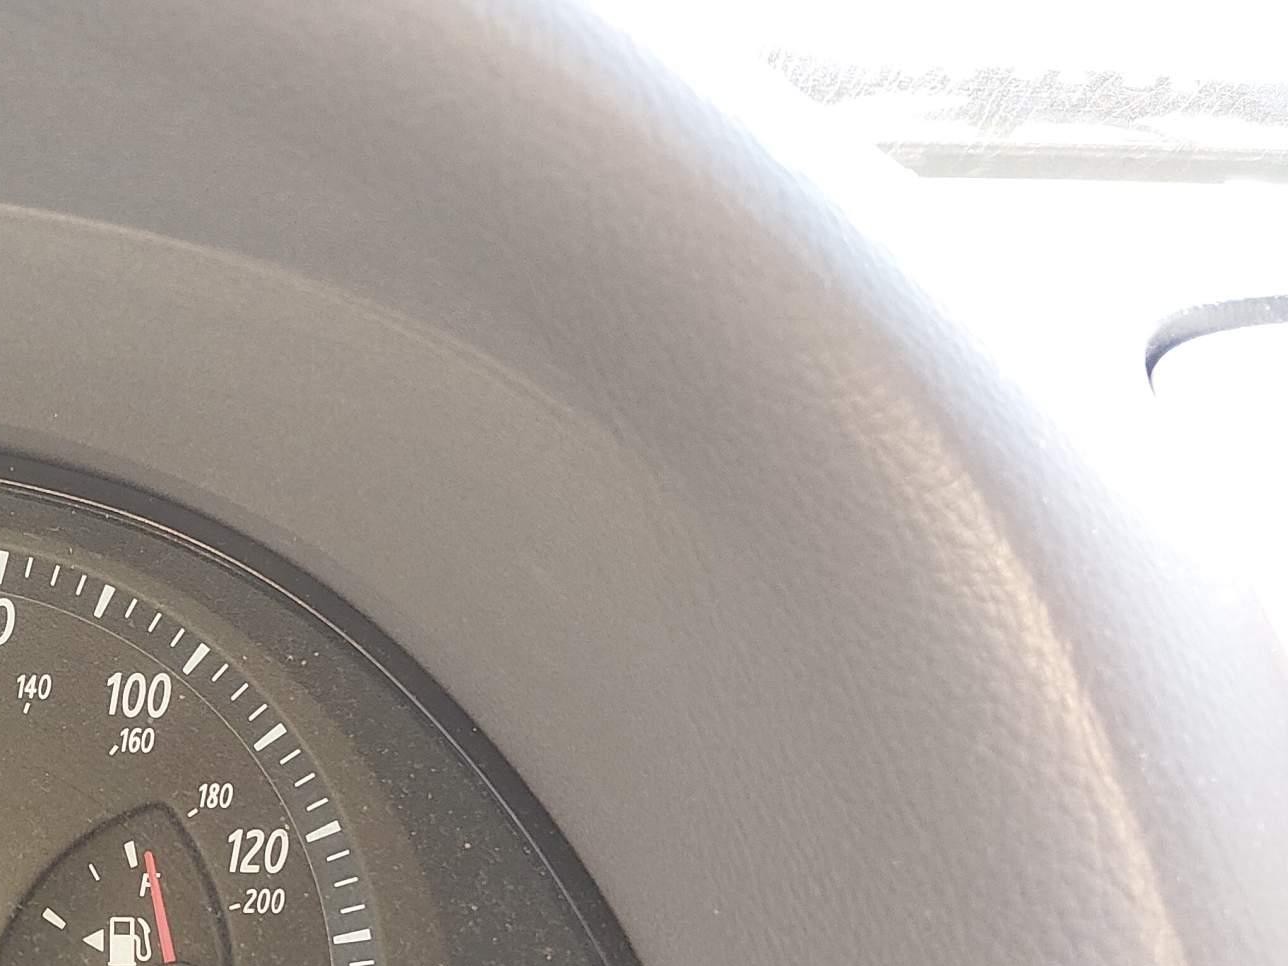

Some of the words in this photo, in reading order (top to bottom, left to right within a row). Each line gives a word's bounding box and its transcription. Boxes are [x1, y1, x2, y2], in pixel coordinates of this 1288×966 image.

[16, 674, 51, 700] 140
[107, 672, 172, 719] 100
[120, 727, 155, 754] 160
[199, 783, 234, 809] 180
[228, 829, 289, 874] 120
[242, 889, 285, 914] 200
